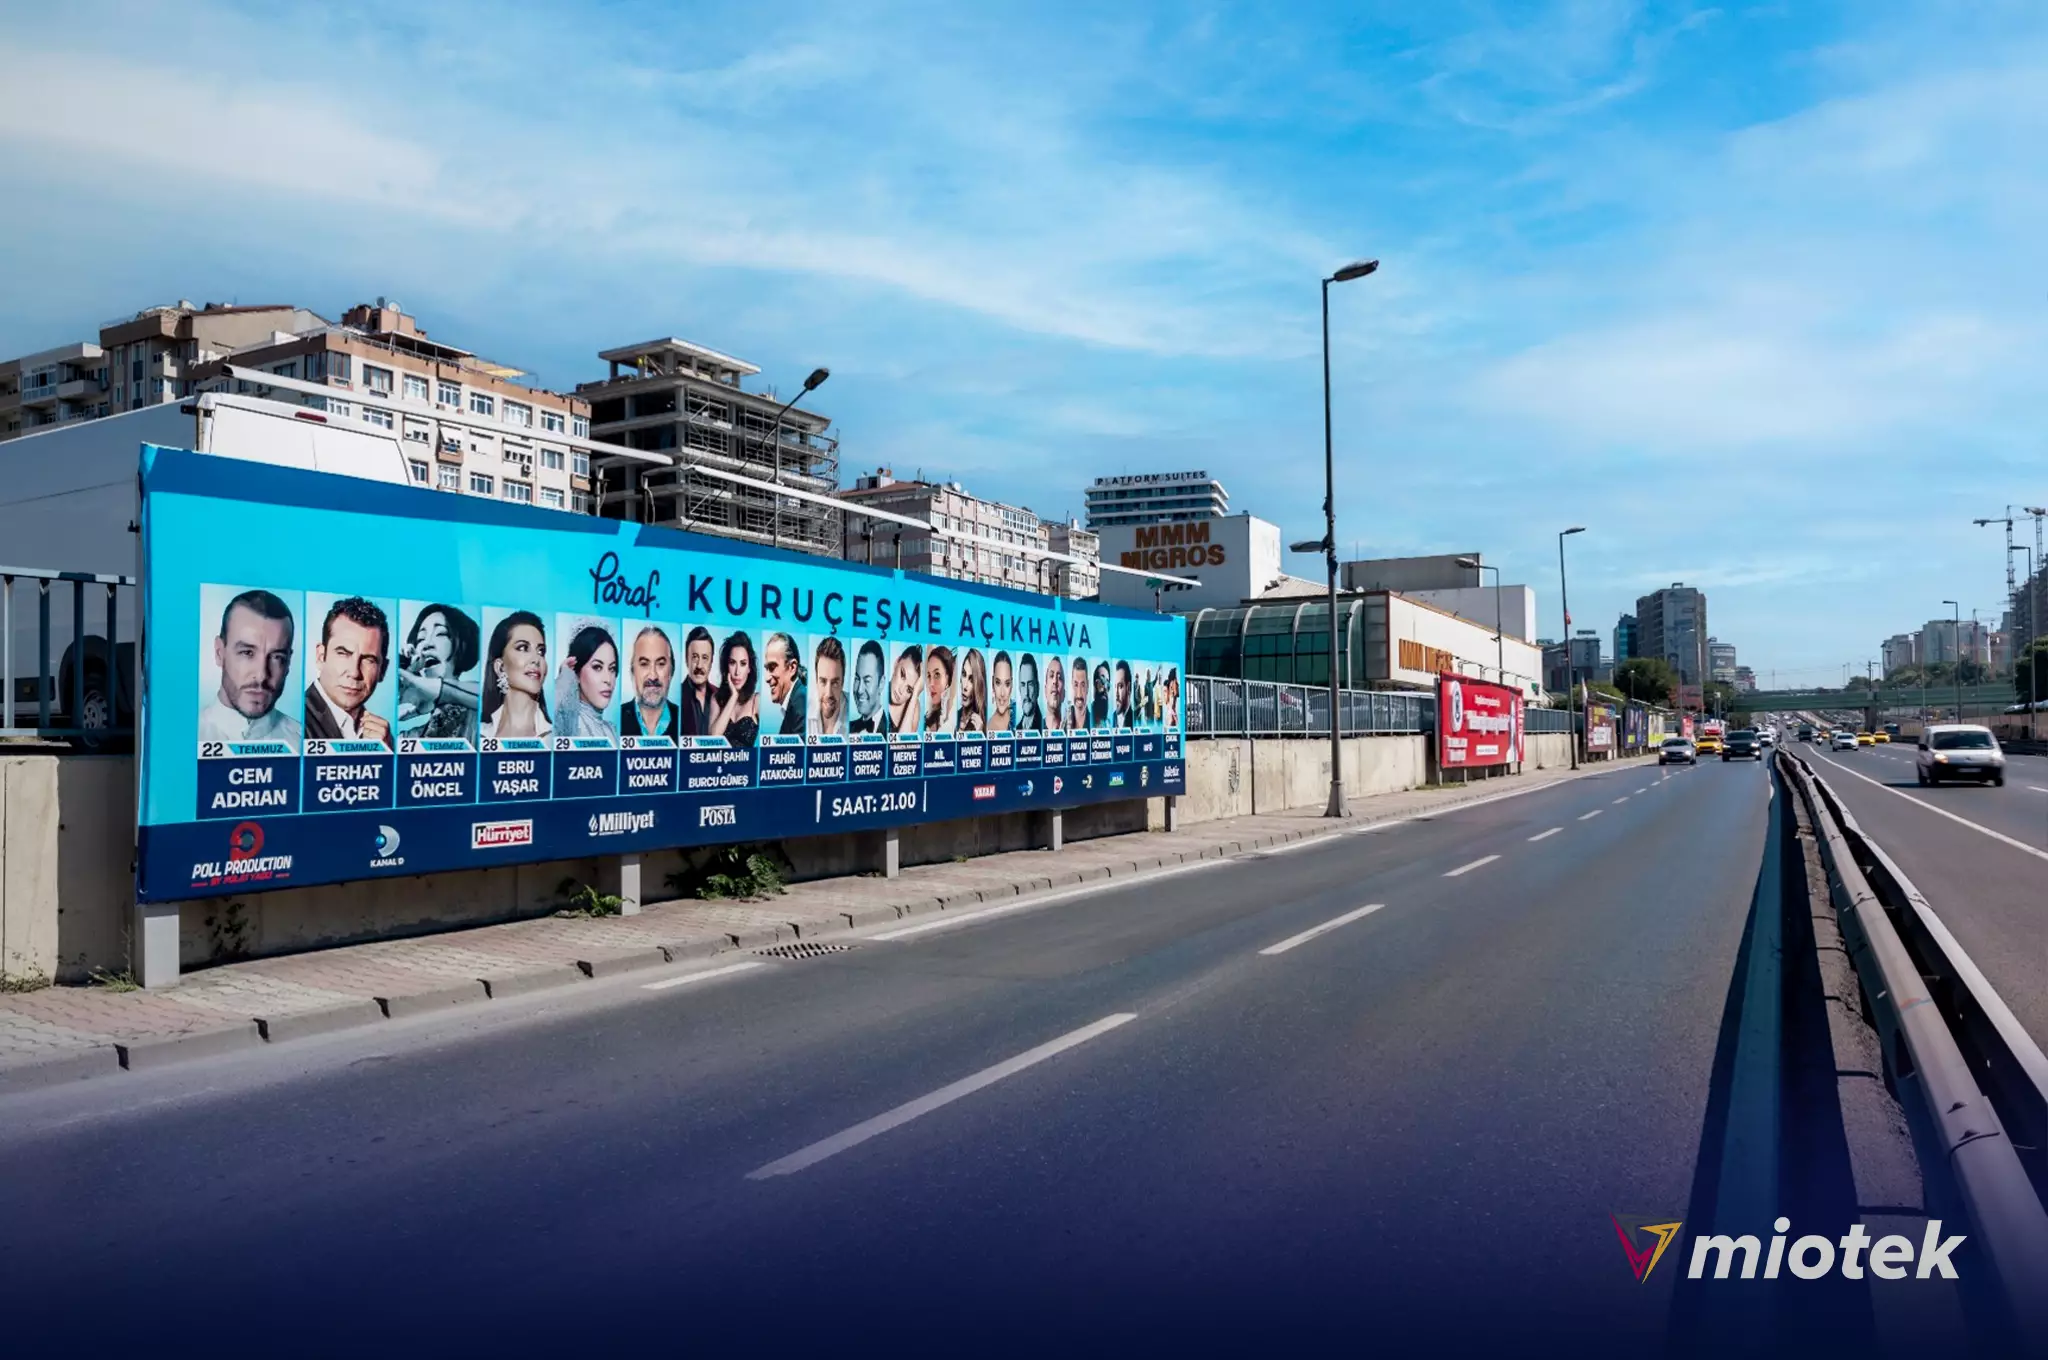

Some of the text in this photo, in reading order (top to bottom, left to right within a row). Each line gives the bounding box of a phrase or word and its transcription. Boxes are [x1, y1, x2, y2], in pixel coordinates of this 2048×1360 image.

[1165, 470, 1206, 480] SUITES
[1136, 522, 1210, 548] MMM
[1120, 544, 1226, 570] MIGROS
[688, 574, 942, 639] KURUÇEŞME
[958, 608, 1092, 649] AÇIKHAVA
[482, 738, 540, 751] 28 TEMMUZ
[556, 738, 608, 750] 29 TEMMUZ
[622, 737, 635, 748] 30
[682, 737, 693, 748] 31
[762, 736, 771, 746] 01
[808, 735, 817, 744] 02
[888, 734, 897, 742] 04
[202, 742, 284, 757] 22 TEMMUZ
[307, 740, 380, 754] 25 TEMMUZ
[400, 740, 464, 752] 27 TEMMUZ
[960, 746, 983, 756] HANDE
[992, 744, 1012, 755] DEMET
[690, 749, 750, 764] SELAMİ ŞAHİN
[769, 751, 796, 765] FAHİR
[812, 752, 842, 764] MURAT
[852, 750, 883, 762] SERDAR
[893, 751, 917, 762] MERVE
[934, 748, 945, 760] NİL
[410, 762, 464, 778] NAZAN
[498, 760, 534, 774] EBRU
[626, 756, 672, 770] VOLKAN
[854, 764, 880, 776] ORTAÇ
[893, 764, 917, 776] ÖZBEY
[228, 767, 272, 785] CEM
[316, 764, 383, 781] FERHAT
[568, 766, 604, 780] ZARA
[760, 766, 804, 781] ATAKOĞLU
[808, 766, 844, 779] DALKILIÇ
[492, 778, 539, 796] YAŞAR
[628, 774, 668, 788] KONAK
[688, 774, 749, 788] BURCU GÜNEŞ
[318, 783, 380, 804] GÖÇER
[411, 780, 464, 798] ÖNCEL
[211, 790, 288, 809] ADRIAN
[832, 791, 916, 817] SAAT: 21.00
[598, 810, 654, 834] Milliyet
[699, 804, 736, 827] POSTA
[475, 826, 530, 845] Hürriyet
[192, 855, 292, 879] POLL PRODUCTION
[370, 857, 404, 868] KANAL D
